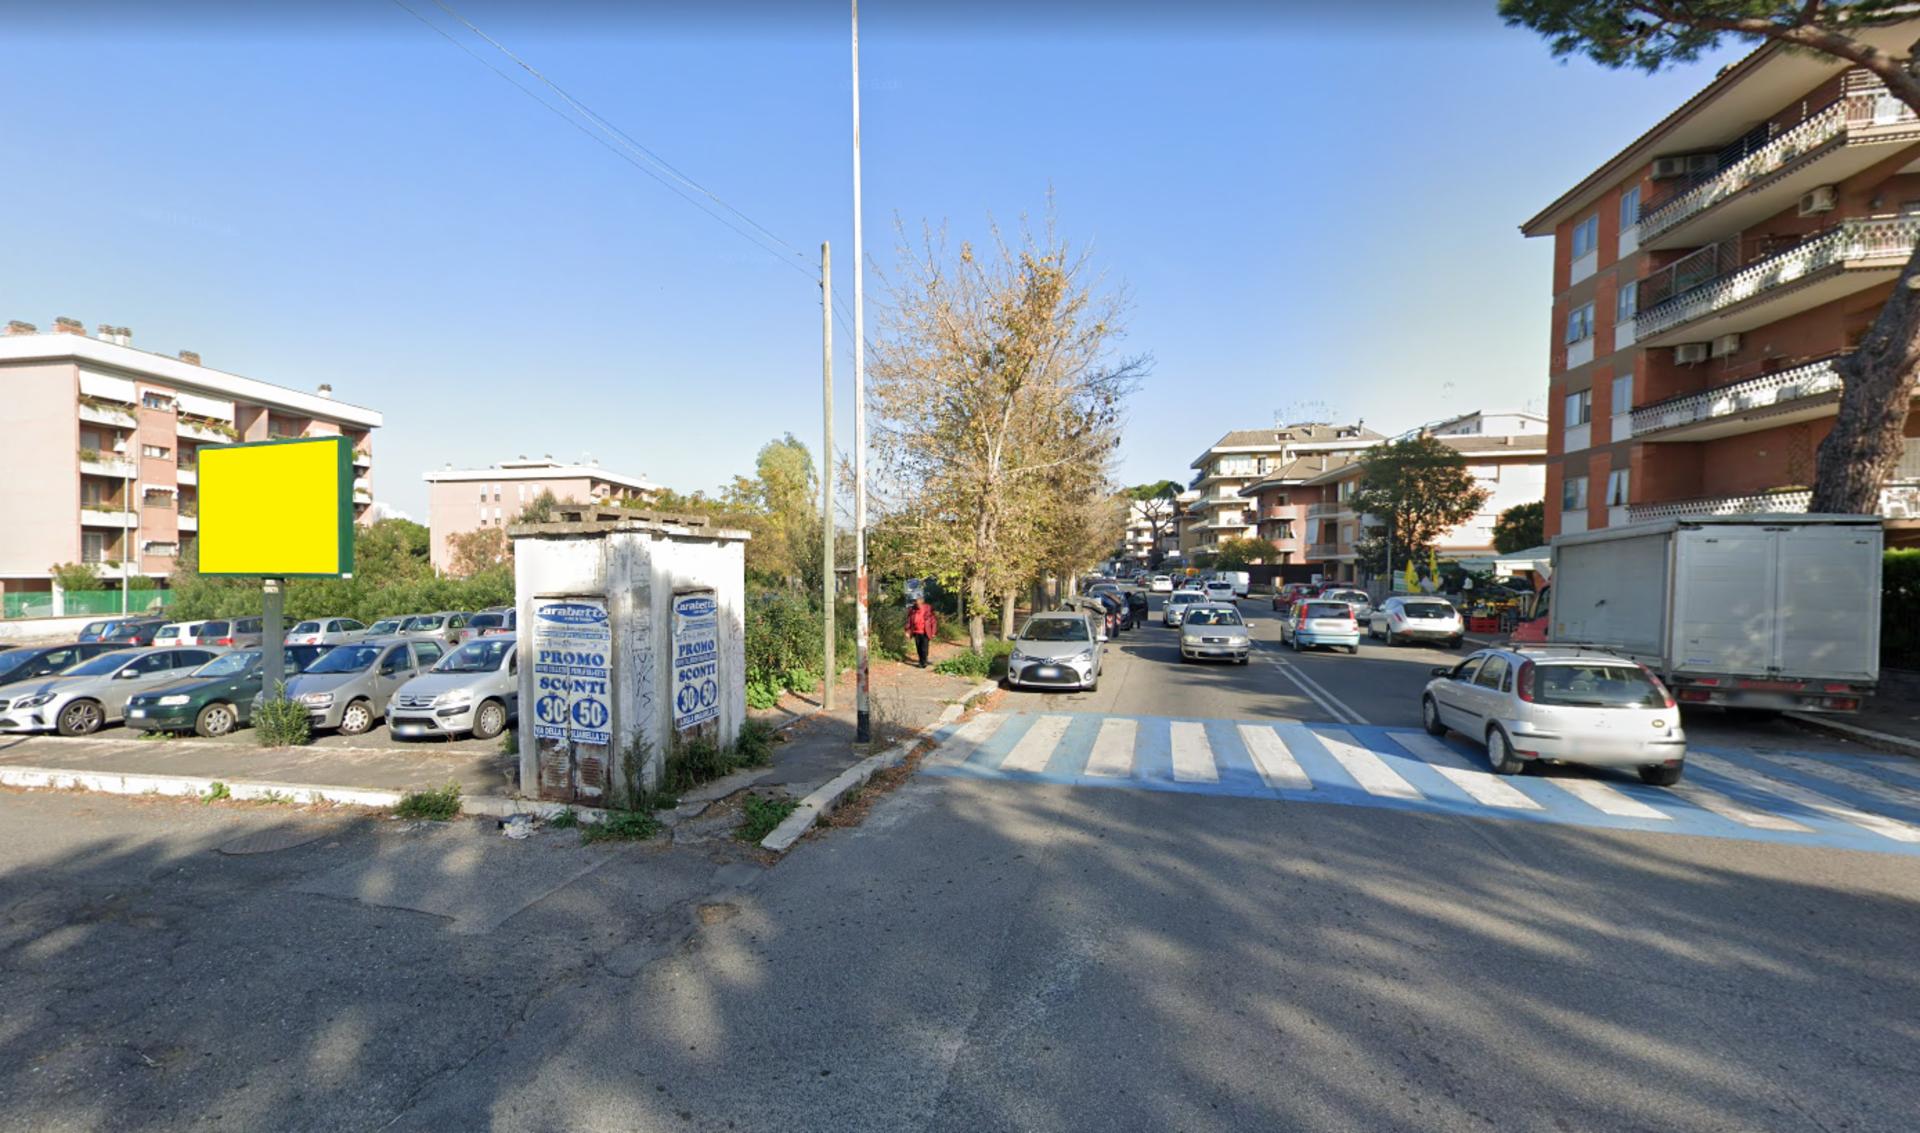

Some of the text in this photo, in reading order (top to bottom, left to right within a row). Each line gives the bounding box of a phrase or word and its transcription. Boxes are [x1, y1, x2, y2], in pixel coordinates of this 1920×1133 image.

[679, 640, 714, 657] PROMO
[539, 650, 605, 667] PROMO
[679, 663, 715, 682] SCONTI
[540, 677, 606, 695] SCONTI
[543, 698, 602, 727] 30 50
